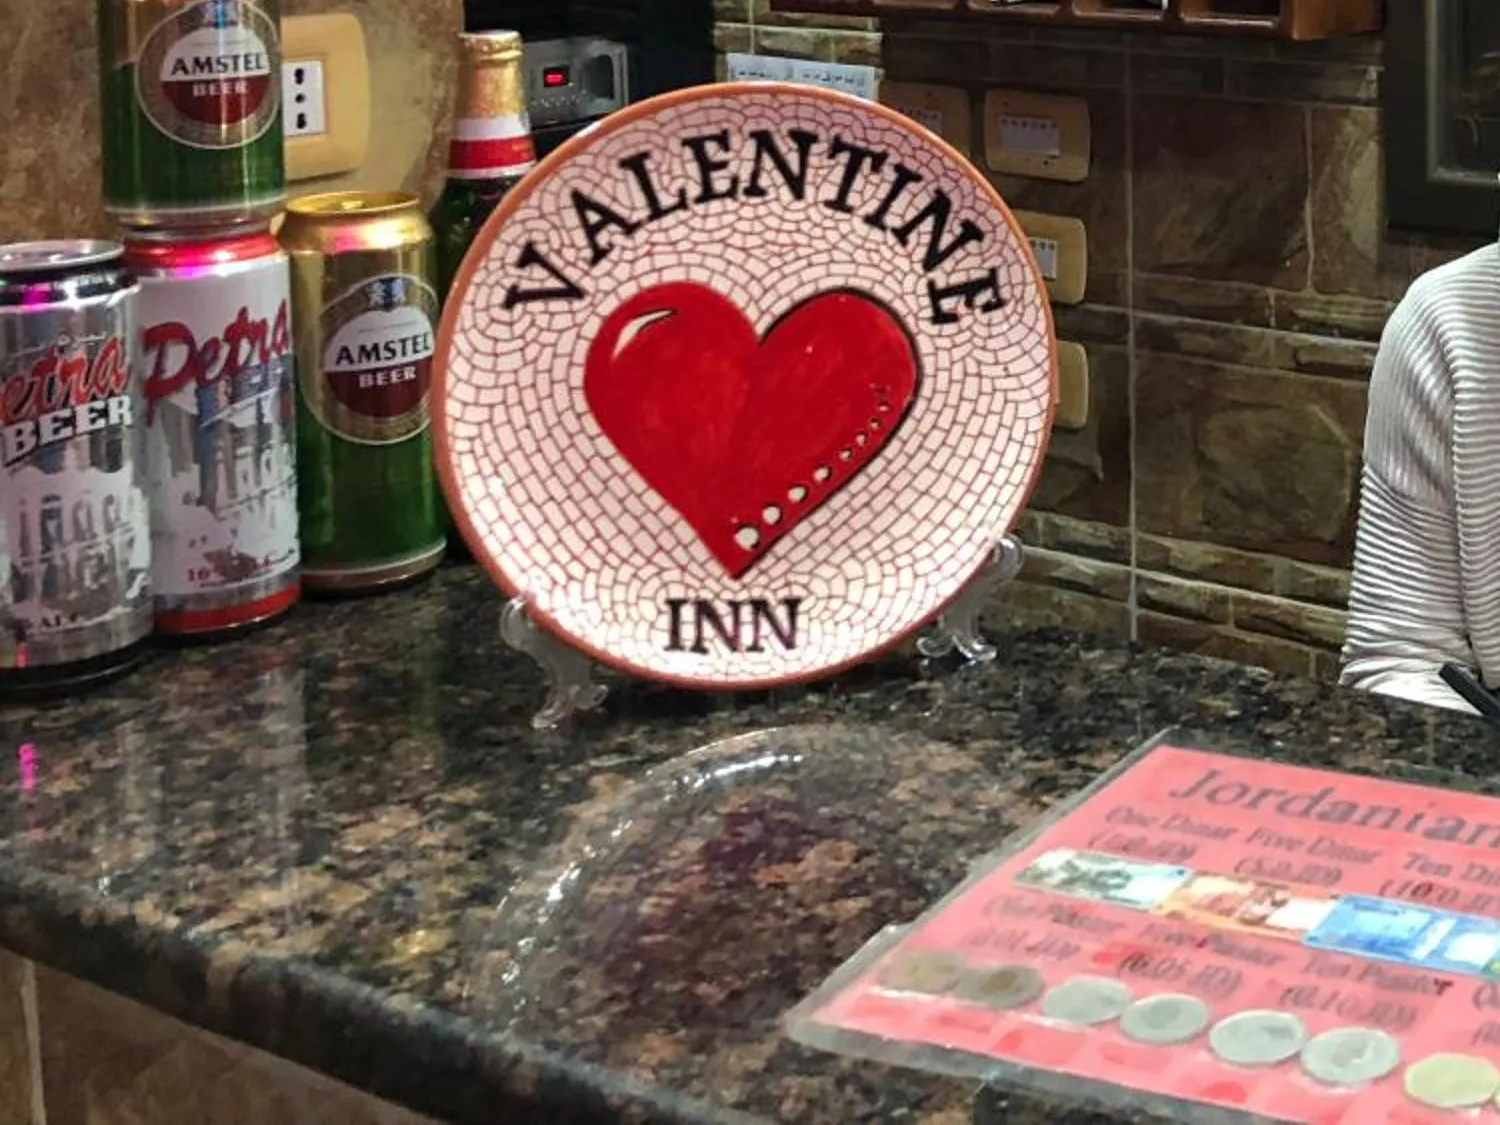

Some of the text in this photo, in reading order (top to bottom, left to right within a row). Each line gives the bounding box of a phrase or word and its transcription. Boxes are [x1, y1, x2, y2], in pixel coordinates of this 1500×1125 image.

[171, 52, 264, 76] AMSTEL
[193, 79, 248, 97] BEER
[503, 128, 1003, 324] VALENTINE
[141, 298, 291, 429] Petra
[335, 332, 431, 366] AMSTEL
[359, 365, 417, 389] BEER
[0, 334, 130, 421] etra
[4, 395, 134, 465] BEER
[664, 597, 801, 653] INN
